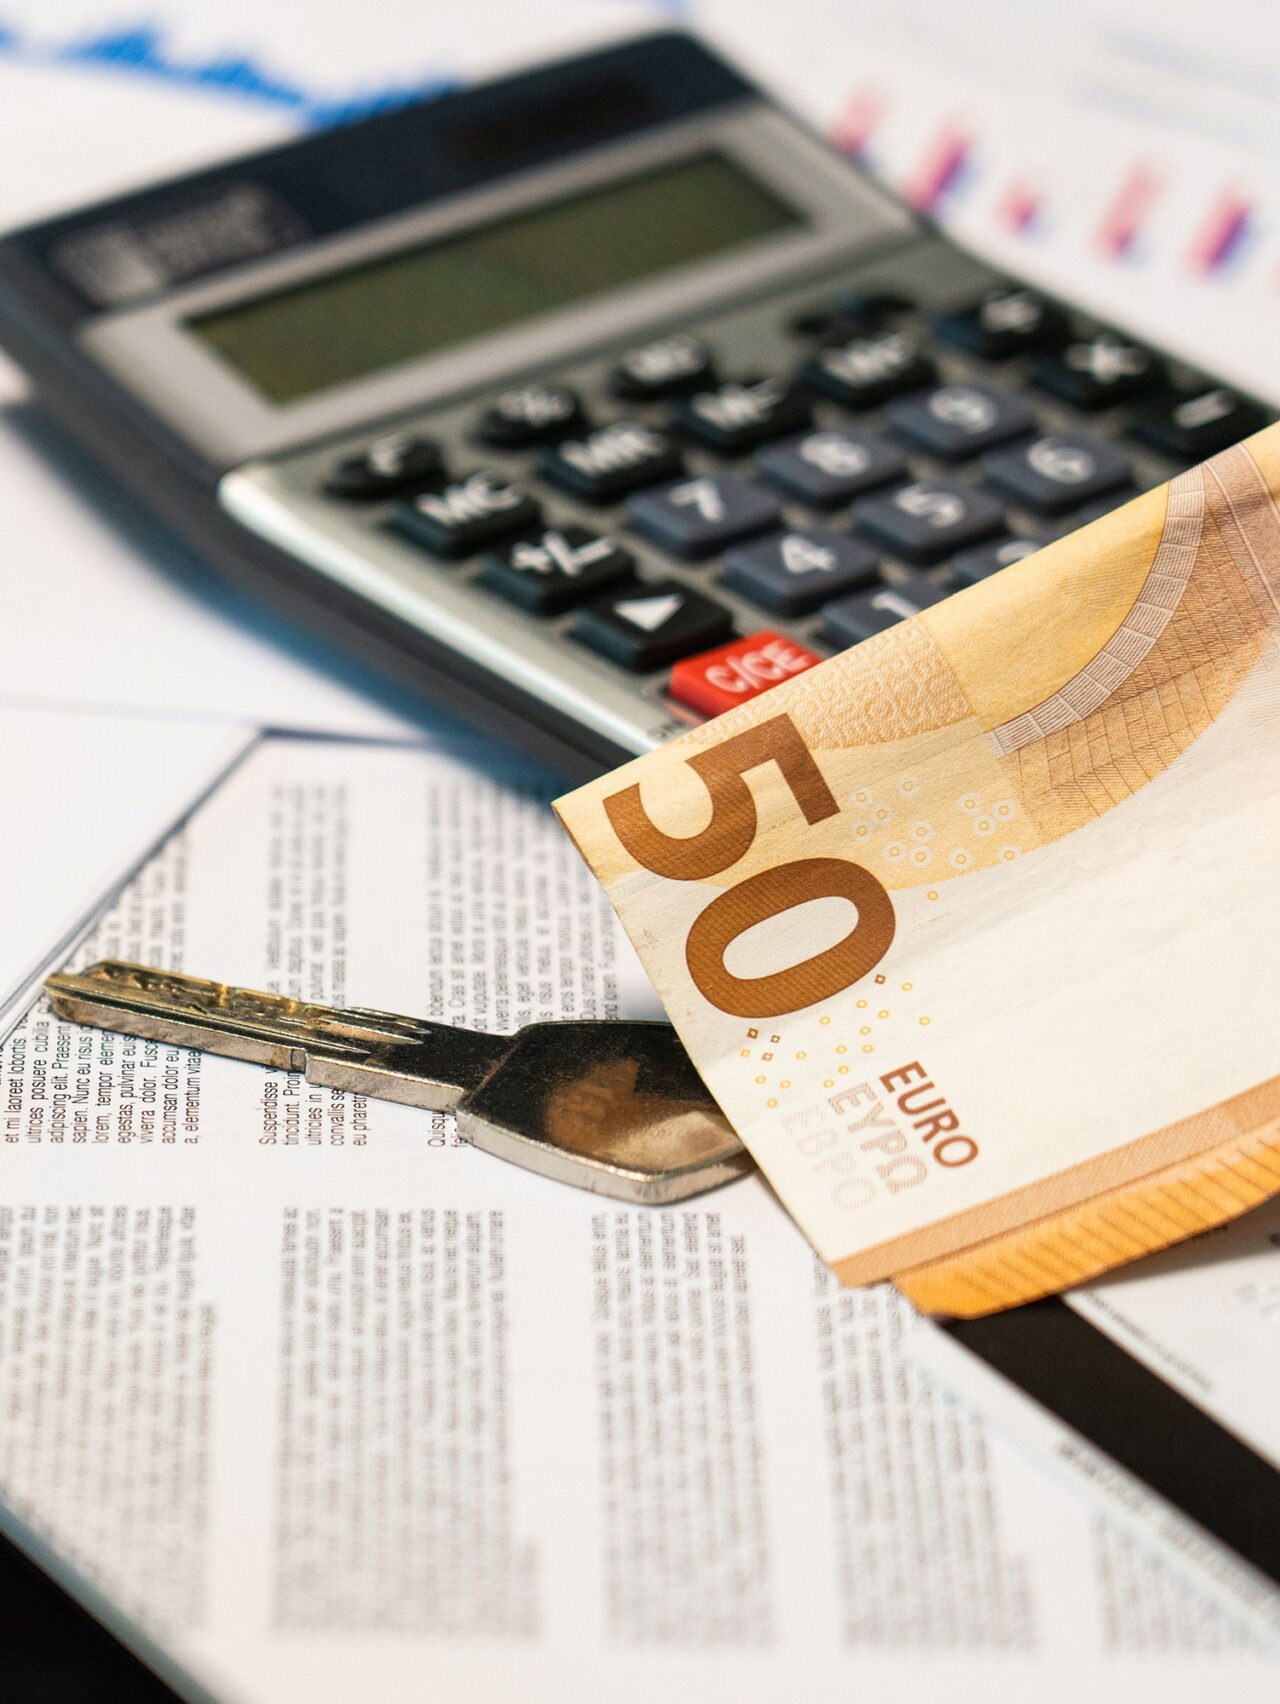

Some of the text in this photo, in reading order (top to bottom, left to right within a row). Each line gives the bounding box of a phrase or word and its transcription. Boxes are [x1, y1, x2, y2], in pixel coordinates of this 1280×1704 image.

[928, 386, 997, 434] 9
[798, 431, 870, 478] 8
[1026, 437, 1096, 484] 6
[416, 470, 522, 526] MC
[668, 478, 727, 521] 7
[895, 481, 966, 528] 5
[779, 533, 838, 575] 4
[704, 640, 812, 694] C/CE
[602, 712, 896, 1019] 50
[4, 1078, 23, 1113] laoreet
[26, 1022, 49, 1143] ultrices posuere cubilia
[47, 1026, 71, 1143] adipiscing elit. Praesent
[71, 1037, 92, 1143] sapien. Nunc eu risus
[95, 1072, 116, 1106] tempor
[117, 1060, 137, 1098] pulvinar
[139, 1076, 156, 1103] dolor.
[161, 1066, 178, 1090] dolor
[4, 1118, 20, 1129] mi
[91, 1113, 112, 1143] lorem,
[117, 1102, 135, 1144] egestas,
[137, 1111, 155, 1144] viverra
[161, 1094, 177, 1144] accumsan
[182, 1078, 200, 1131] elementum
[258, 1082, 280, 1145] Suspendisse
[282, 1102, 300, 1145] tincidunt.
[305, 1094, 323, 1145] ultricies in
[328, 1103, 346, 1146] convallis
[351, 1093, 371, 1146] eu pharetr
[879, 1060, 979, 1170] EURO
[5, 1134, 19, 1143] et
